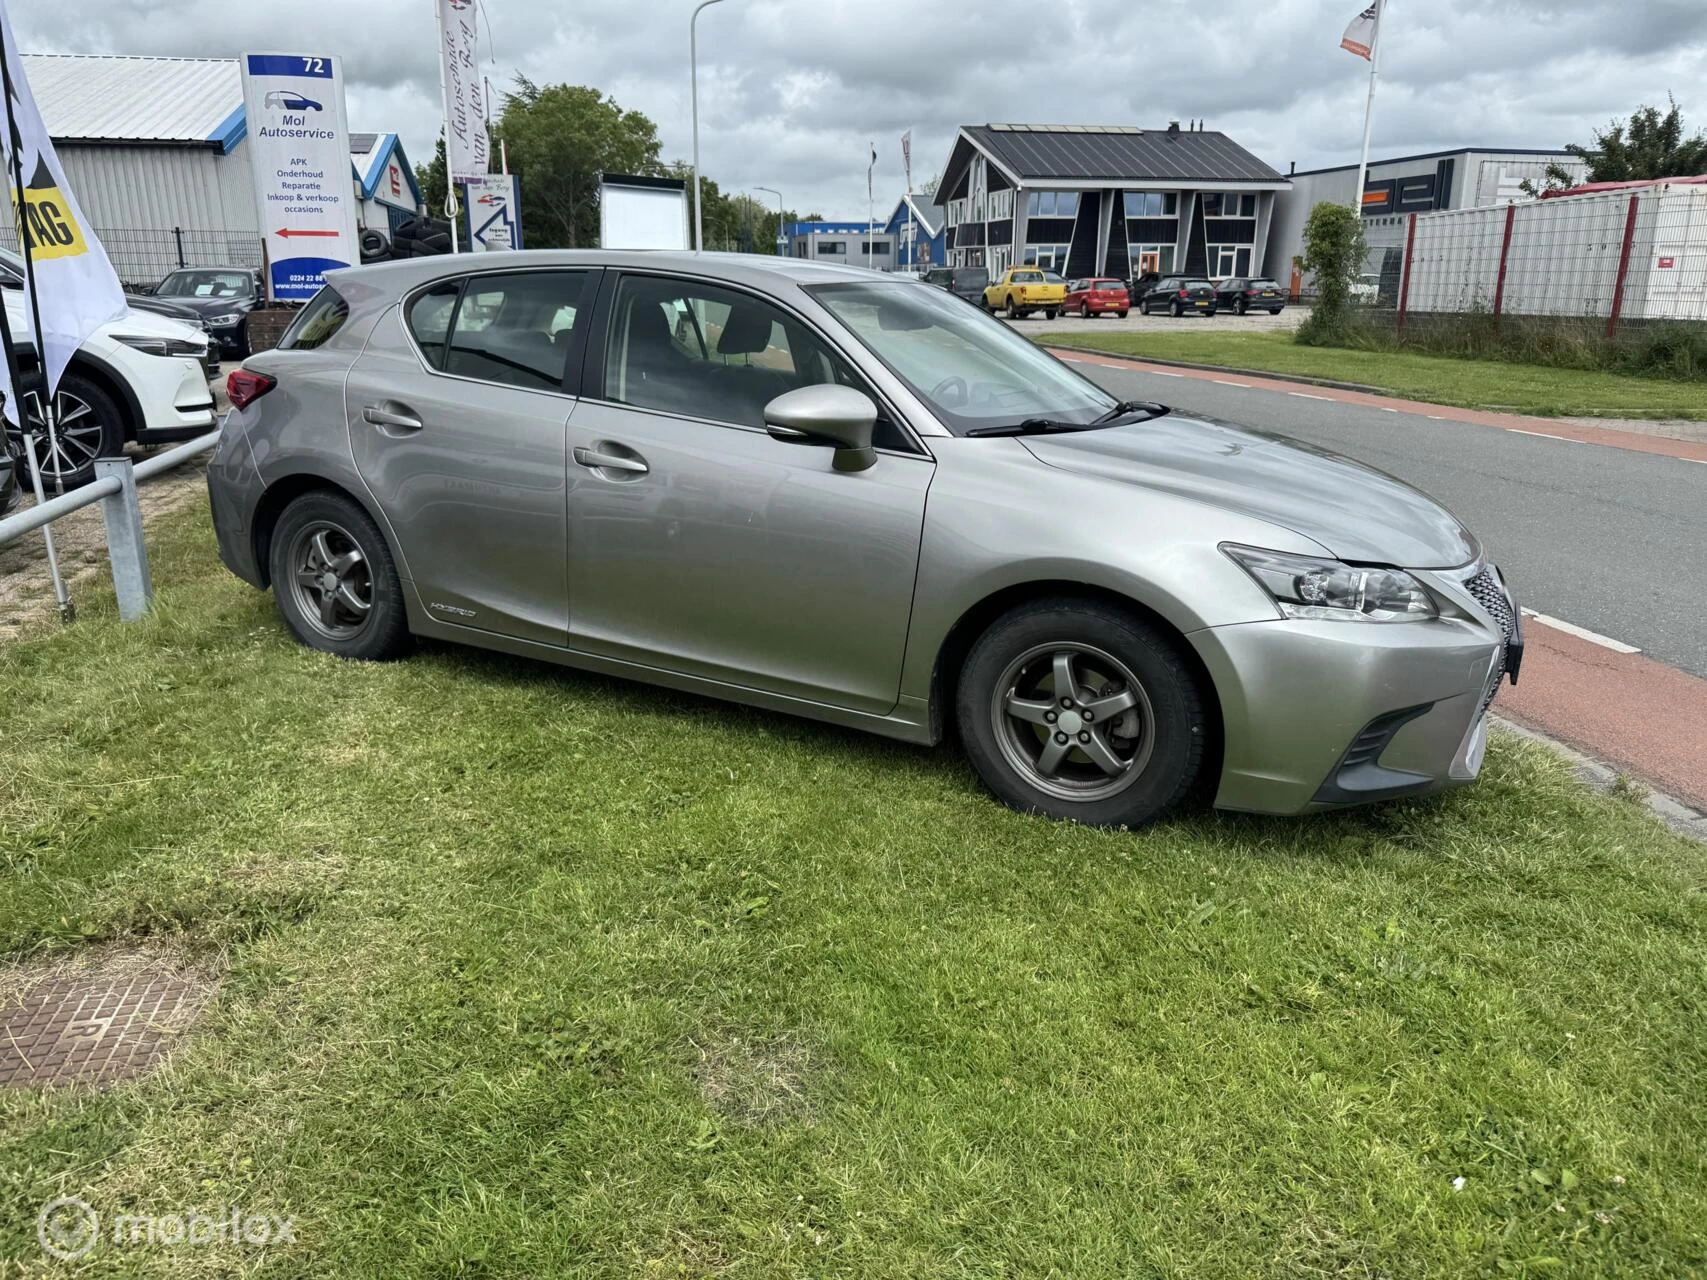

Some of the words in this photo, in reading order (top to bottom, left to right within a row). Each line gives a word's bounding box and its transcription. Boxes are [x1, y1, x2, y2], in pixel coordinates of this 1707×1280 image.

[302, 57, 324, 73] 72
[446, 30, 469, 150] Autoschade
[469, 82, 484, 119] den
[282, 115, 306, 126] Mol
[259, 127, 335, 139] Autoservice
[474, 131, 486, 165] van
[290, 158, 308, 166] APK
[277, 170, 324, 178] Onderhoud
[281, 181, 321, 190] Reparatie
[1361, 158, 1455, 216] bell
[267, 193, 295, 203] Inkoop
[296, 193, 303, 201] &
[305, 194, 339, 203] verkoop
[284, 205, 324, 213] occasions
